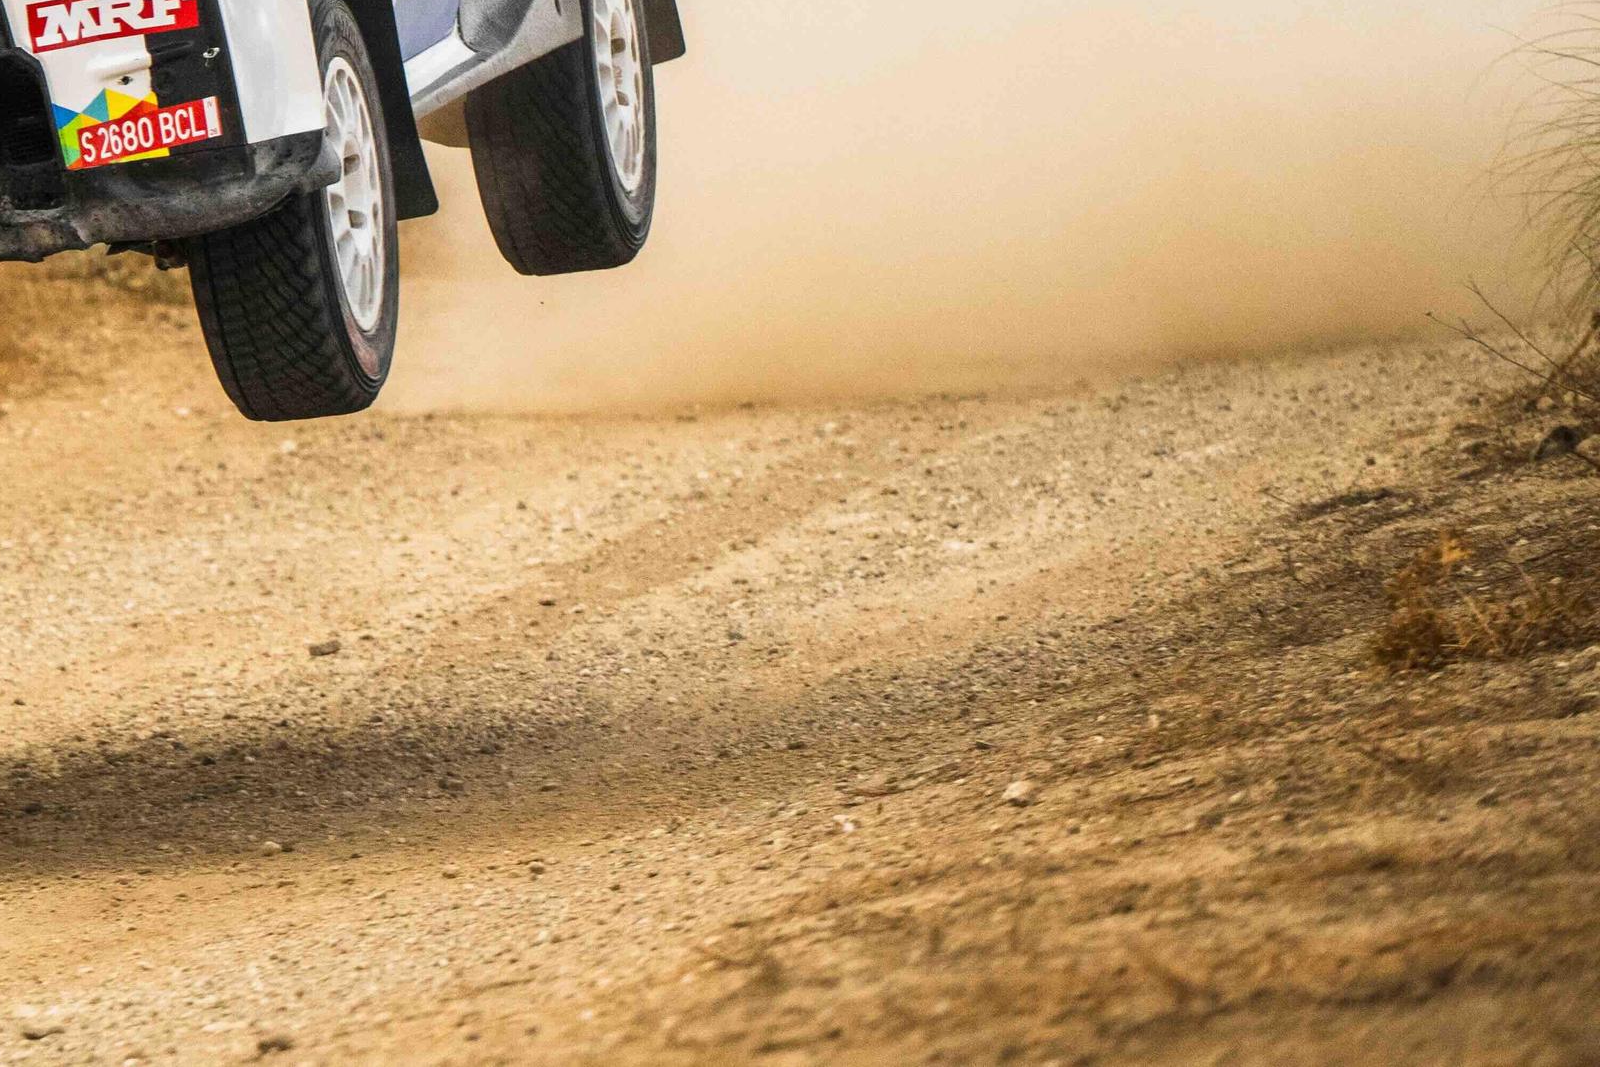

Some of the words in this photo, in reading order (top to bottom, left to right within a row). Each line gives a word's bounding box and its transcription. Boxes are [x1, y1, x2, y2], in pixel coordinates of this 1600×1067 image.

[81, 130, 96, 163] S
[99, 116, 155, 160] 2680
[160, 107, 207, 147] BCL
